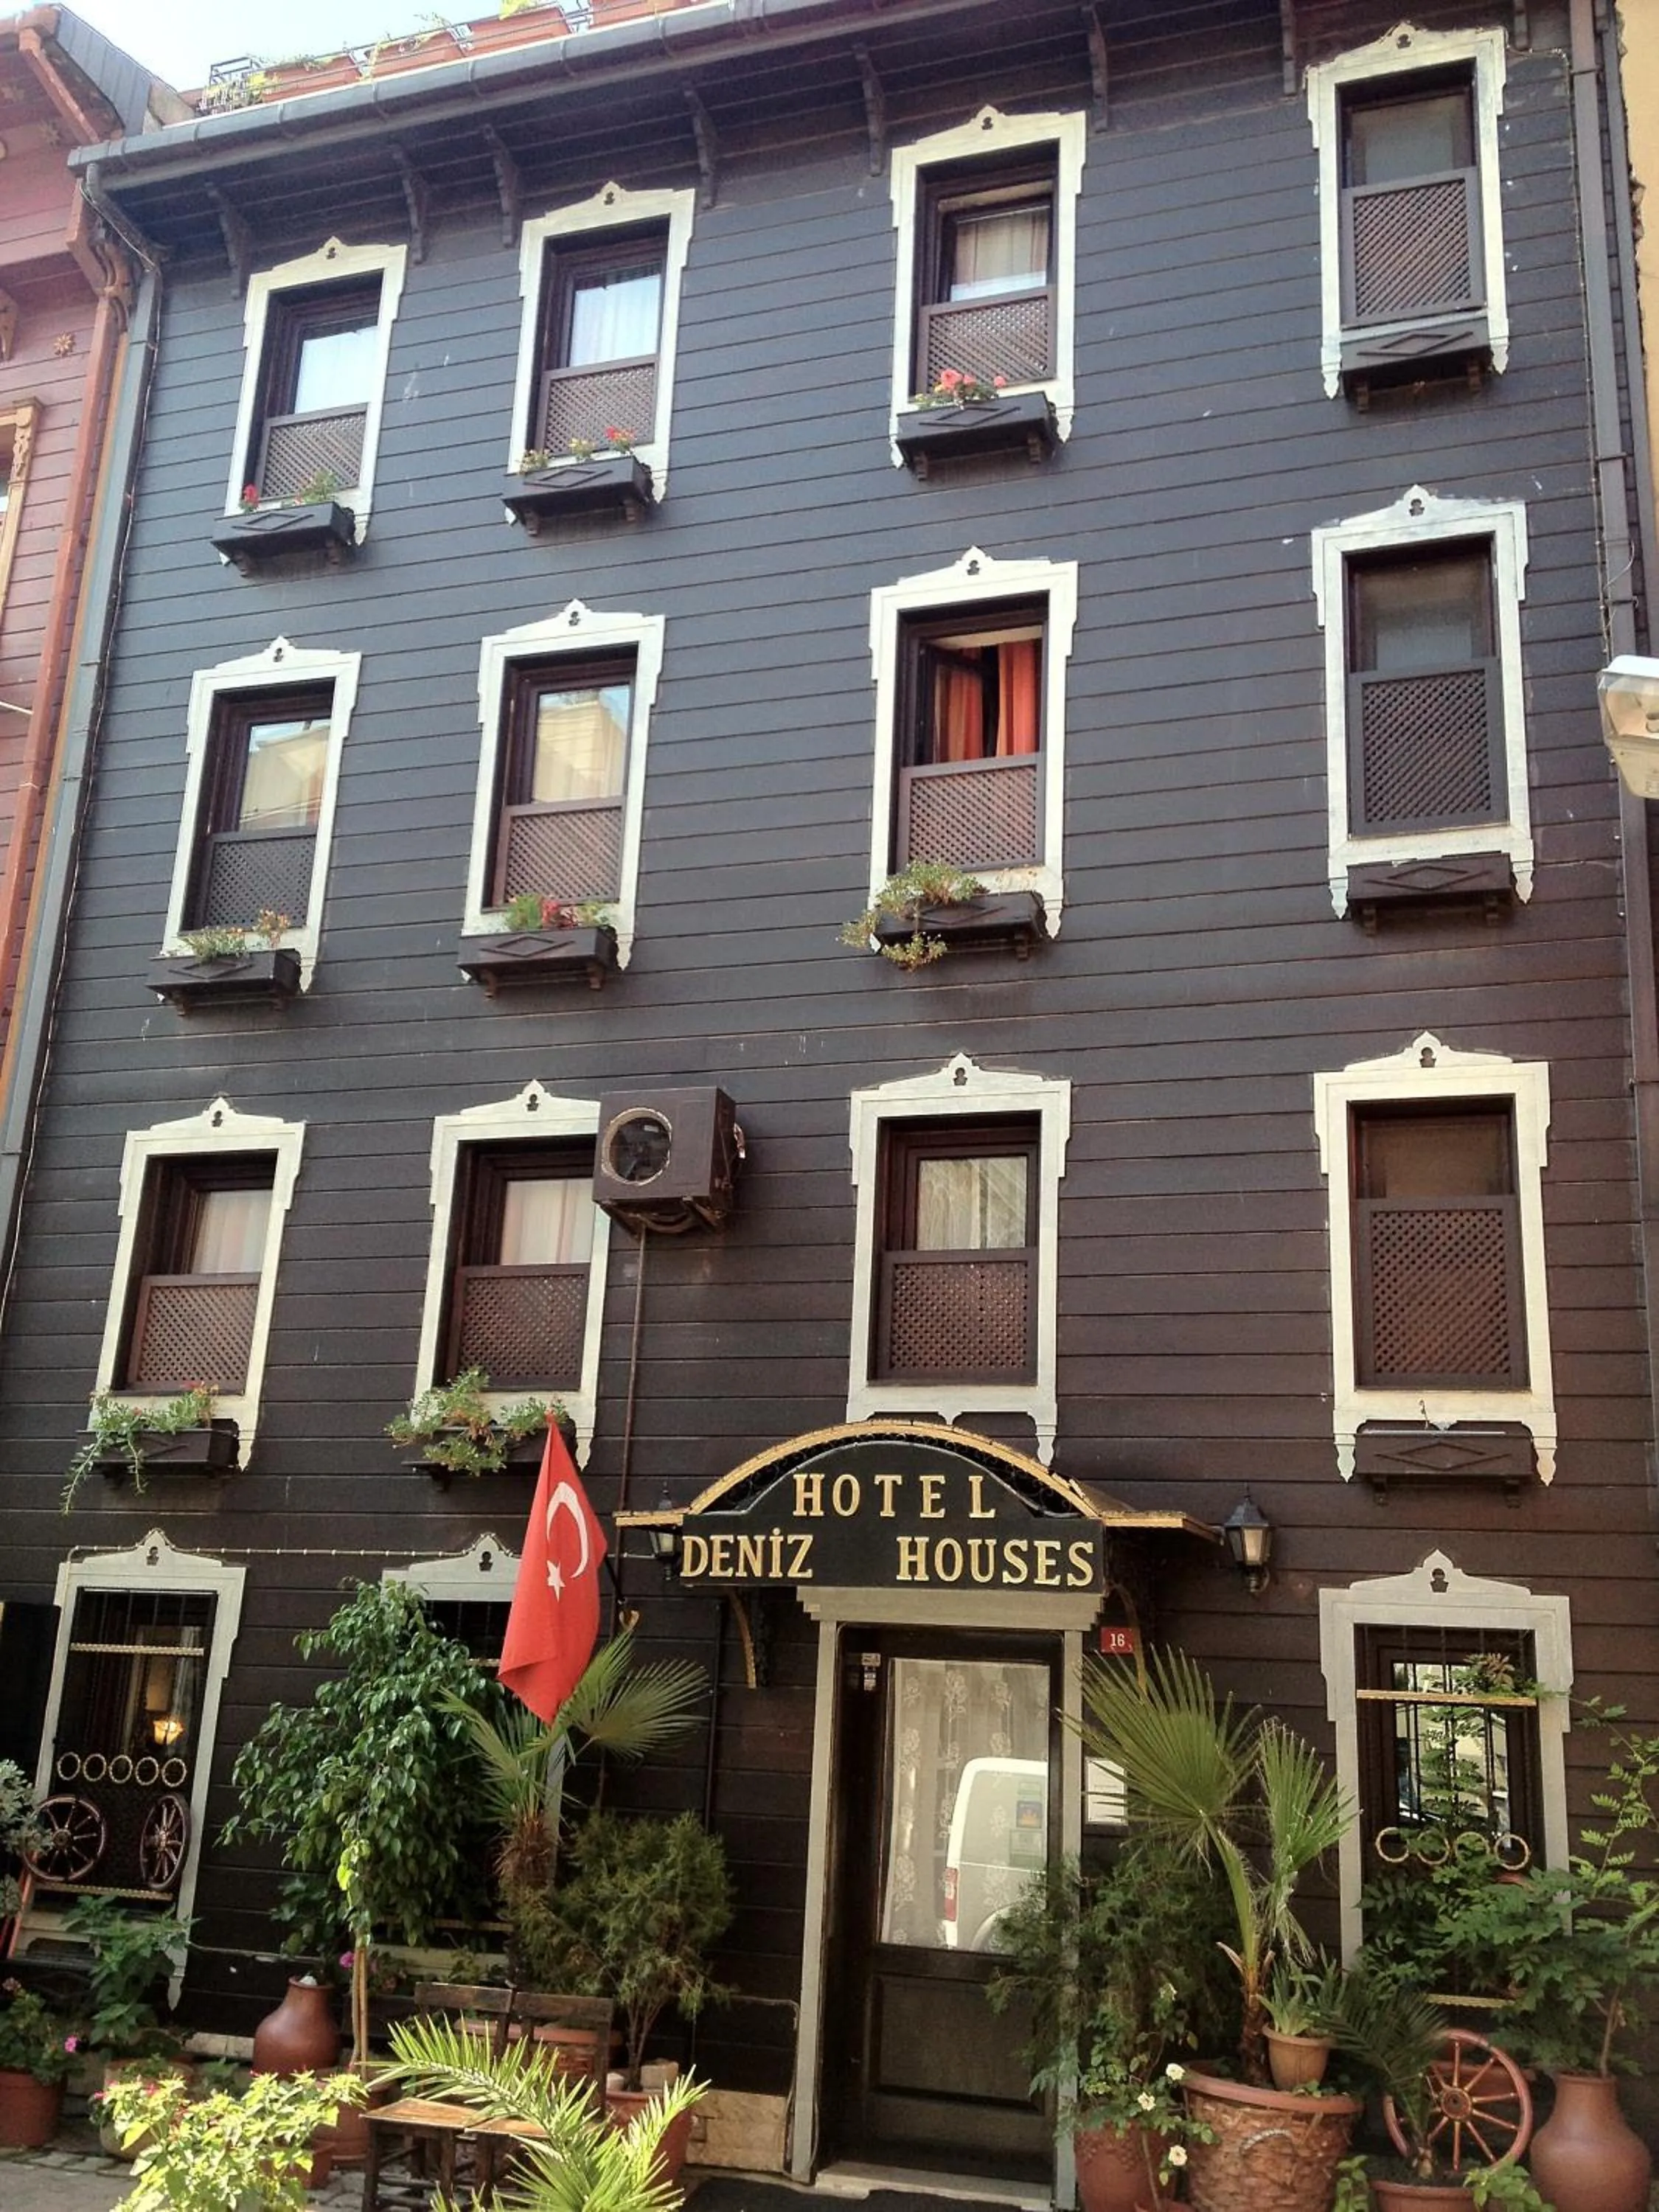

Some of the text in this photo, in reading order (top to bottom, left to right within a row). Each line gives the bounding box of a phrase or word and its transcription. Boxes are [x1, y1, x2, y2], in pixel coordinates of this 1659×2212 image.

[793, 1473, 995, 1518] HOTEL
[681, 1528, 1094, 1587] DENİZ HOUSES
[1110, 1633, 1125, 1647] 16
